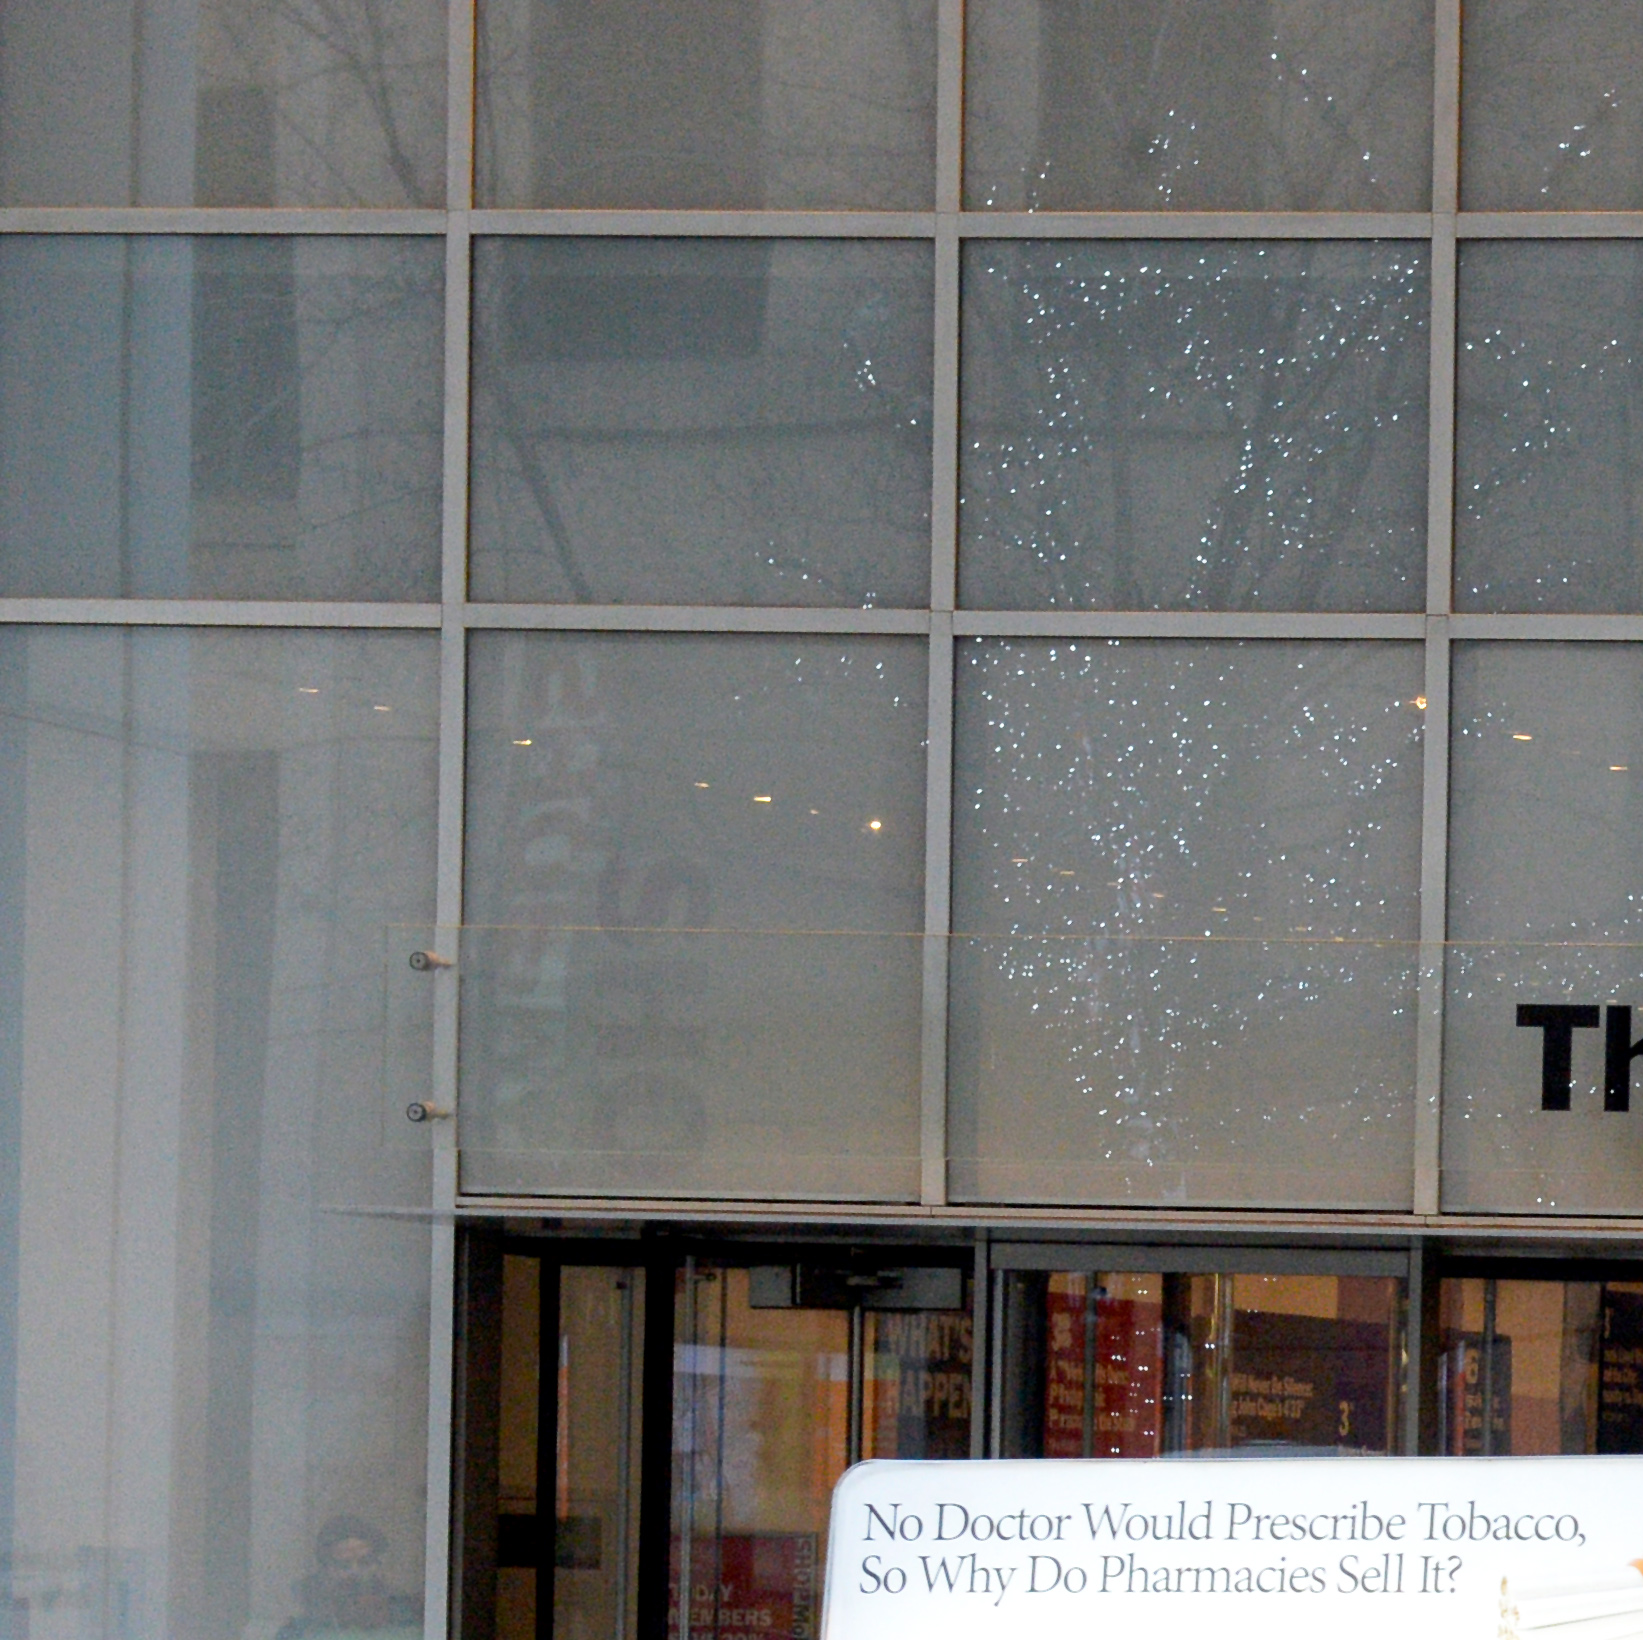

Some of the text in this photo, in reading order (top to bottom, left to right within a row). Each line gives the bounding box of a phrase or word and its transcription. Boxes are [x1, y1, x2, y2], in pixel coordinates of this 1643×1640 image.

[863, 1500, 1586, 1547] No Doctor Would Prescribe Tobacco,
[859, 1553, 1462, 1607] So Why Do Pharmacies Sell It?
